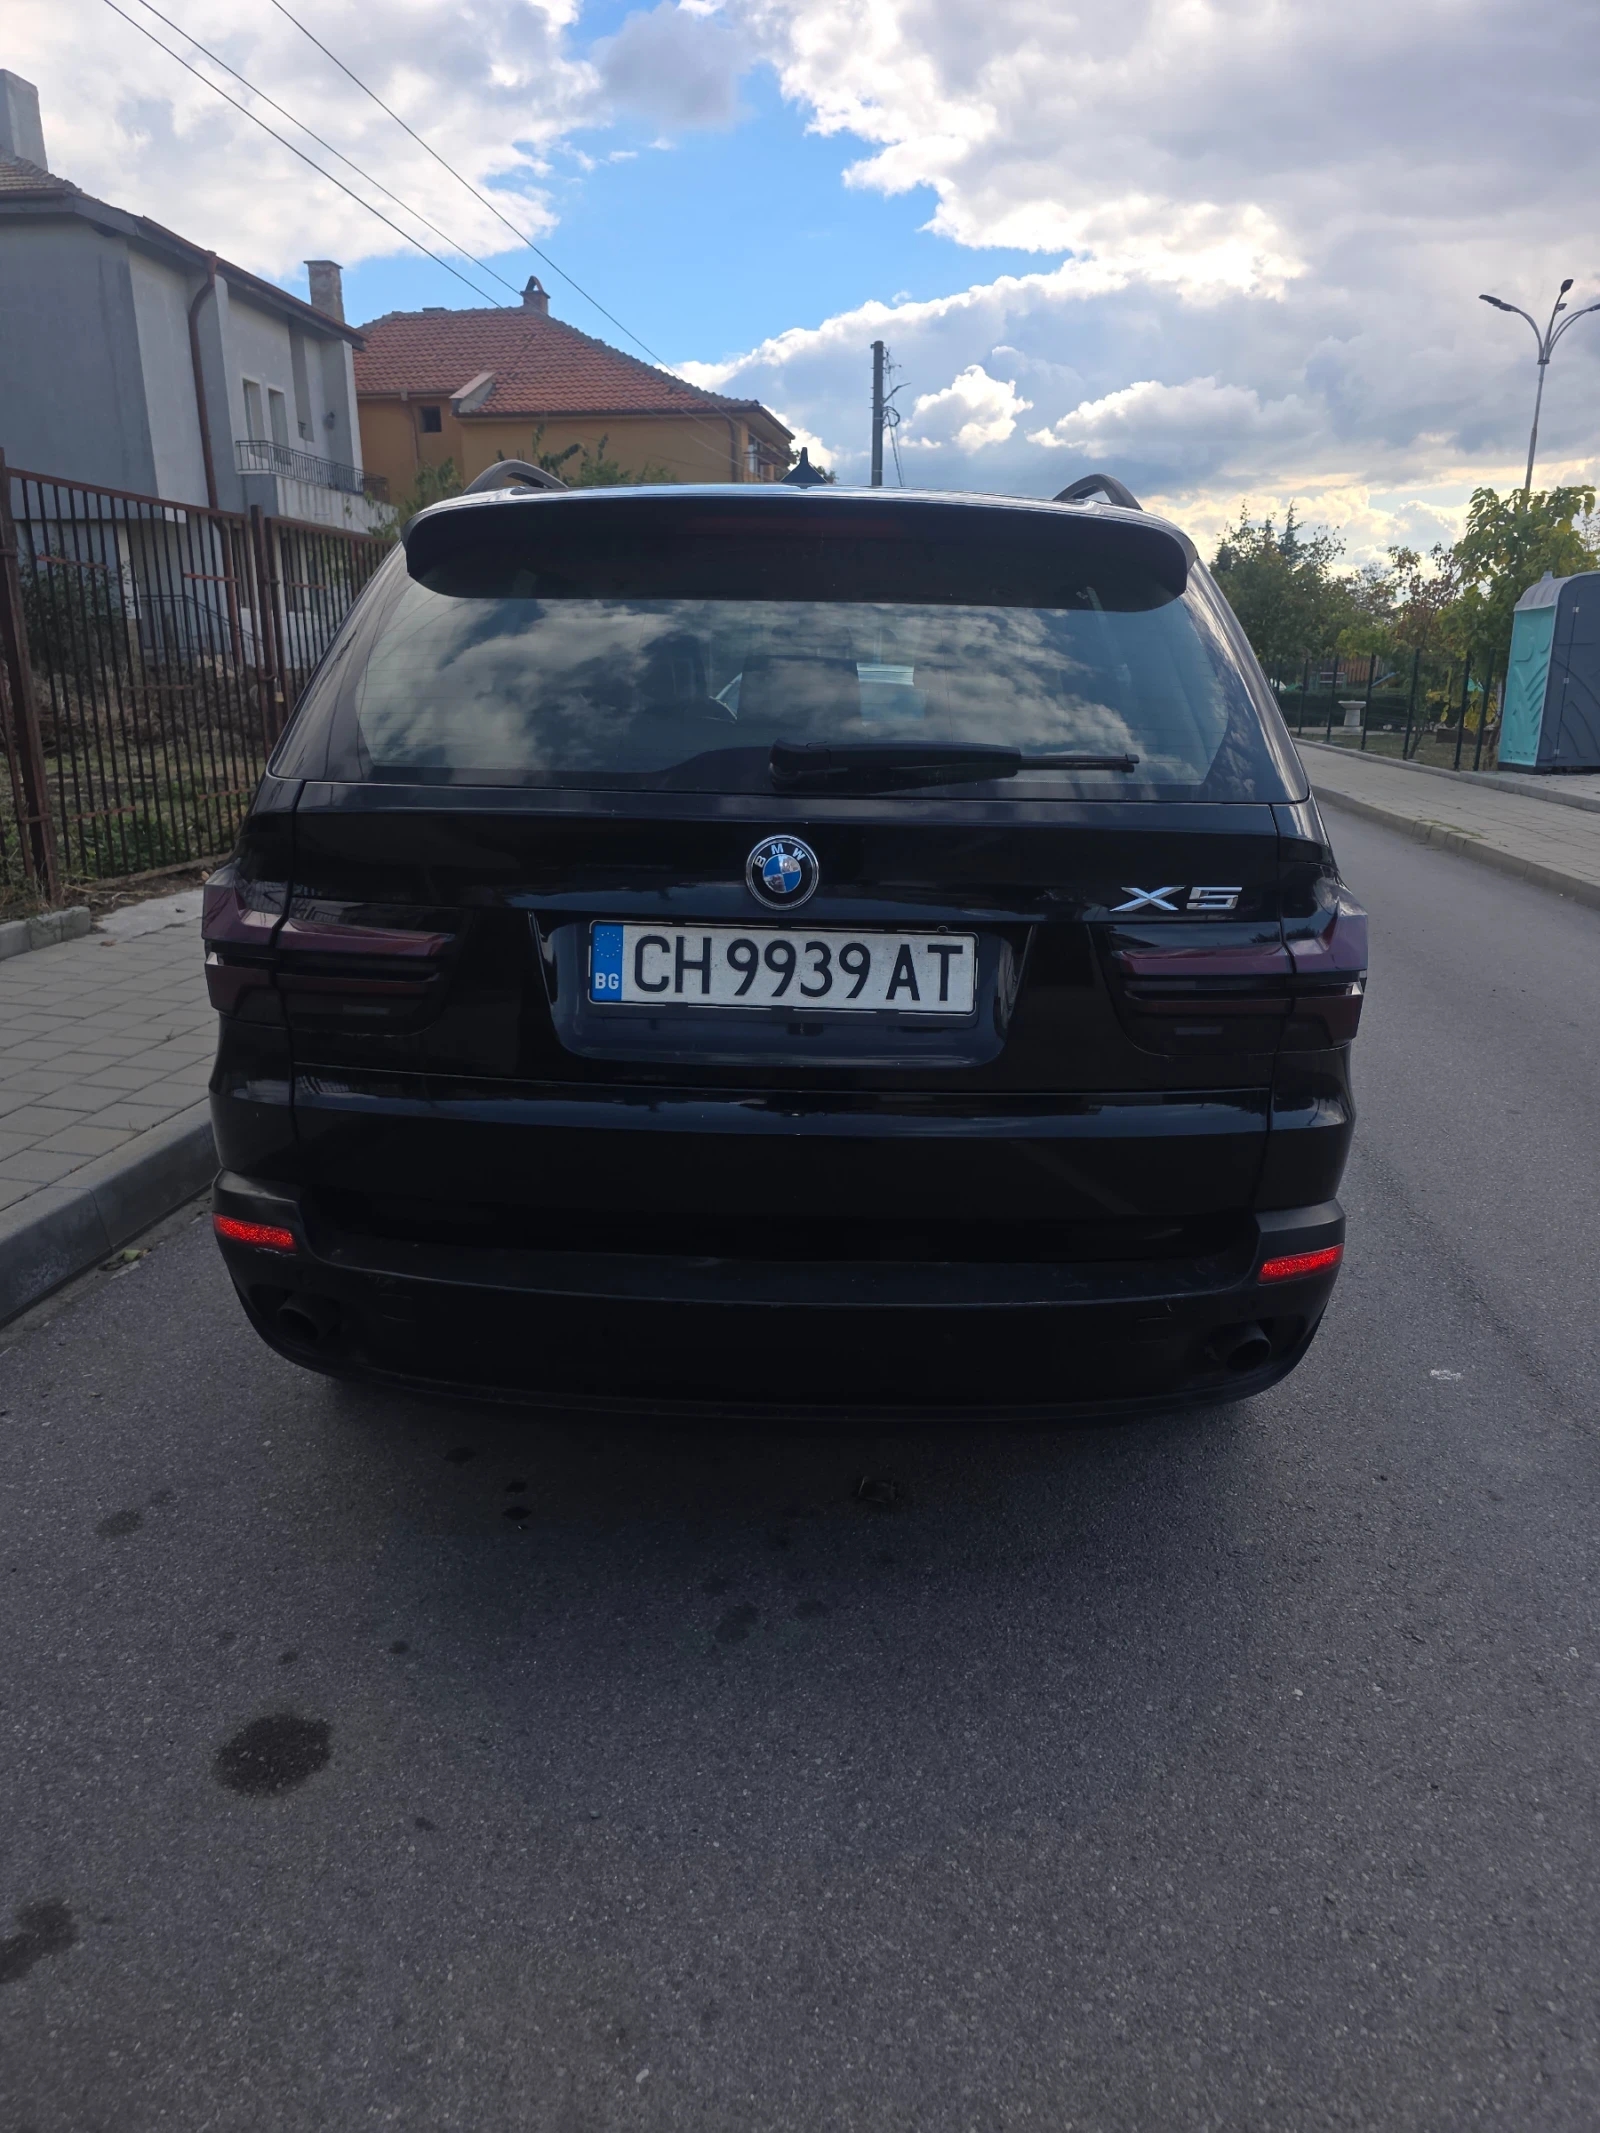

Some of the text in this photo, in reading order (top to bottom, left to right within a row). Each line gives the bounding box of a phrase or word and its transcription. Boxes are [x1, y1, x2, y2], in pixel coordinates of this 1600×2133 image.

[754, 843, 806, 868] BMW
[1109, 885, 1243, 912] X5
[633, 935, 964, 1001] CH 9939 AT
[595, 972, 620, 991] BG
